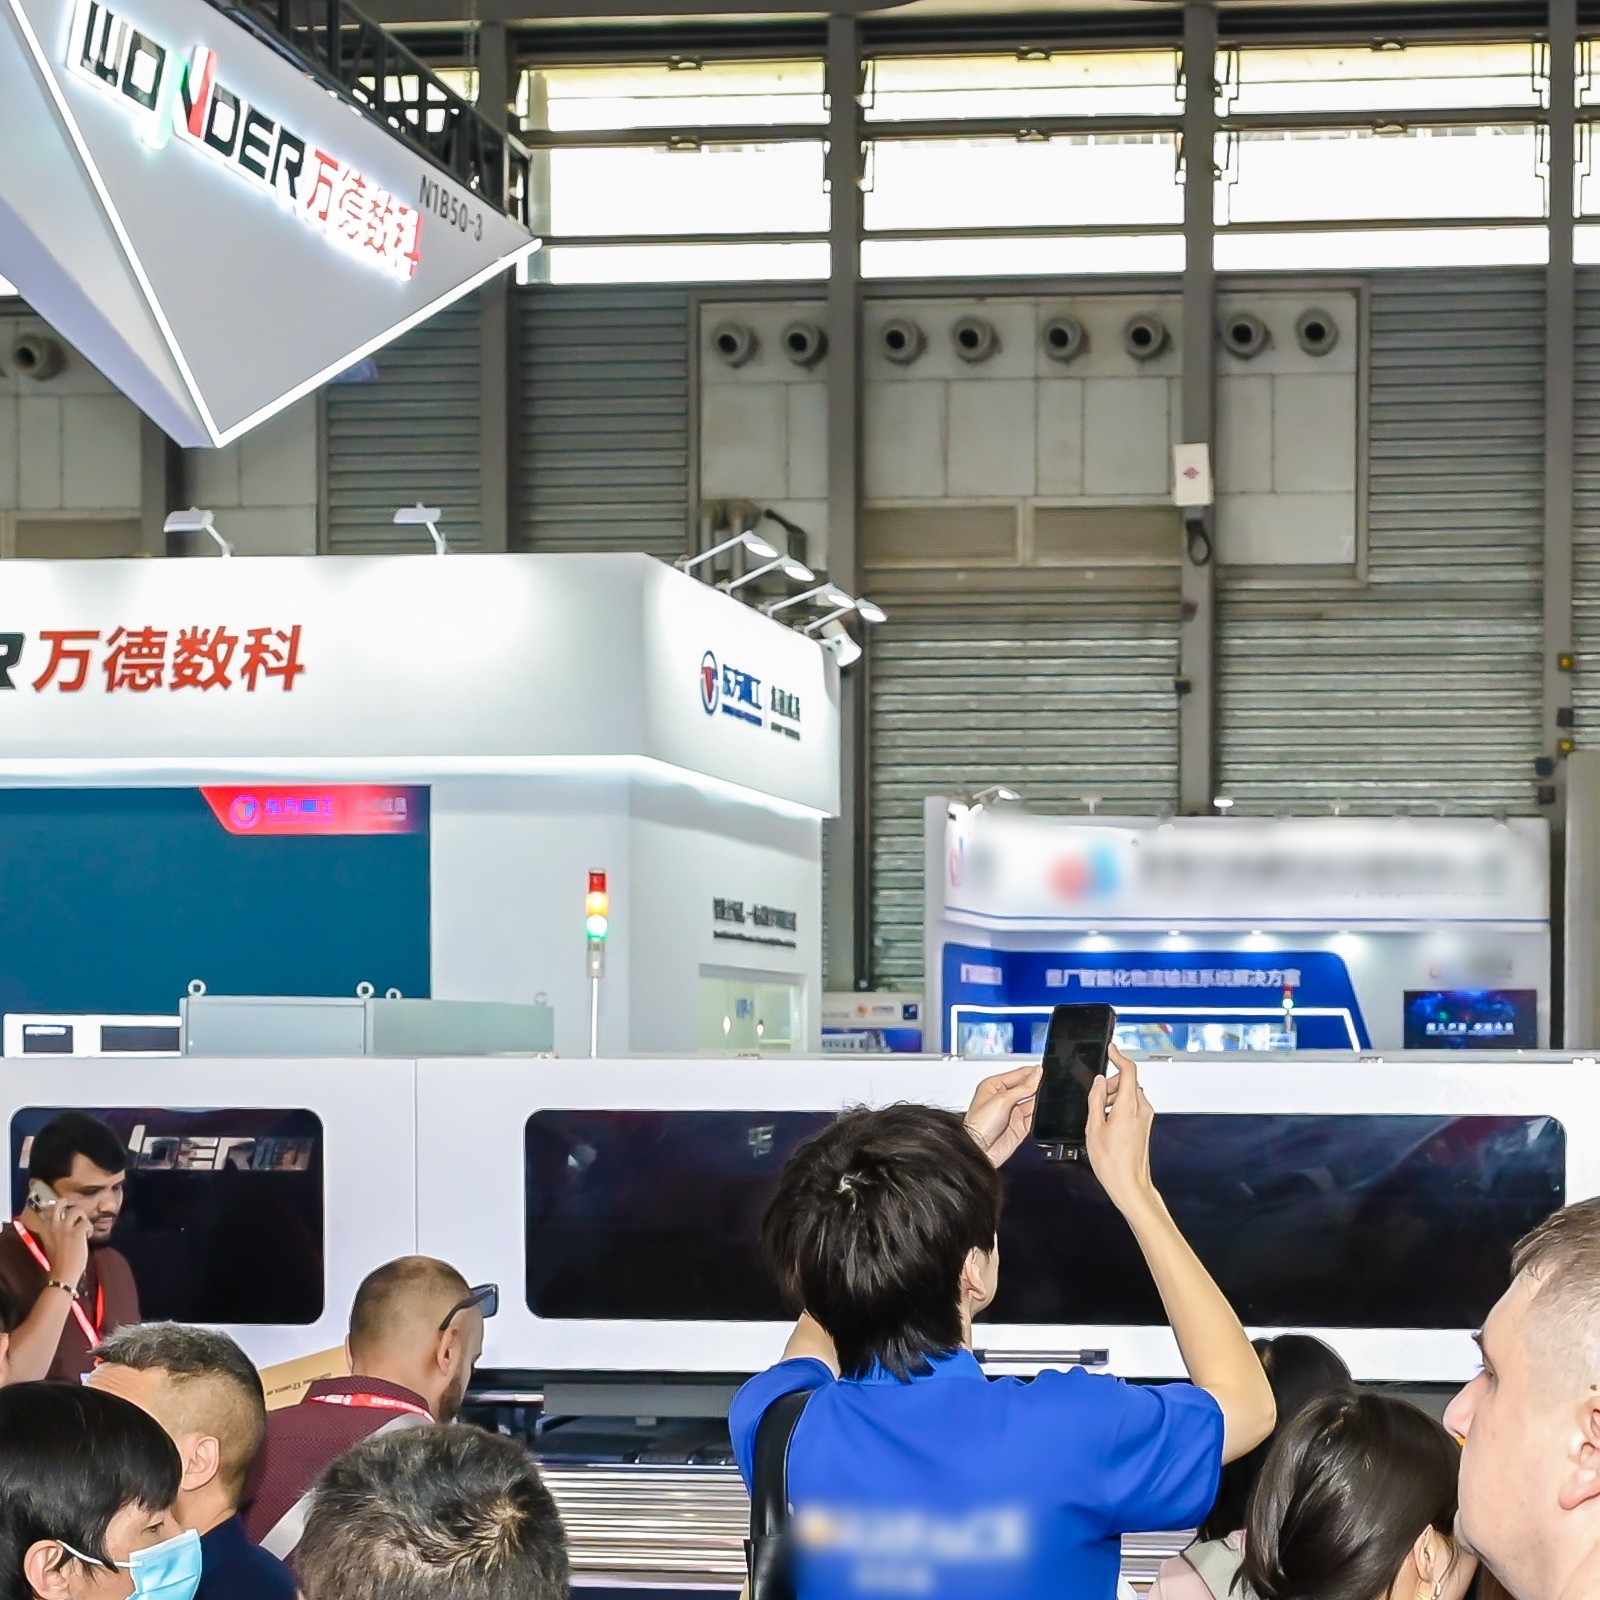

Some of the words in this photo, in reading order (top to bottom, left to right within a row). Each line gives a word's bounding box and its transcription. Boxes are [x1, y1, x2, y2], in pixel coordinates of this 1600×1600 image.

[72, 2, 307, 207] WONDER
[418, 175, 484, 241] N1B50-3
[32, 624, 306, 694] 万德数科
